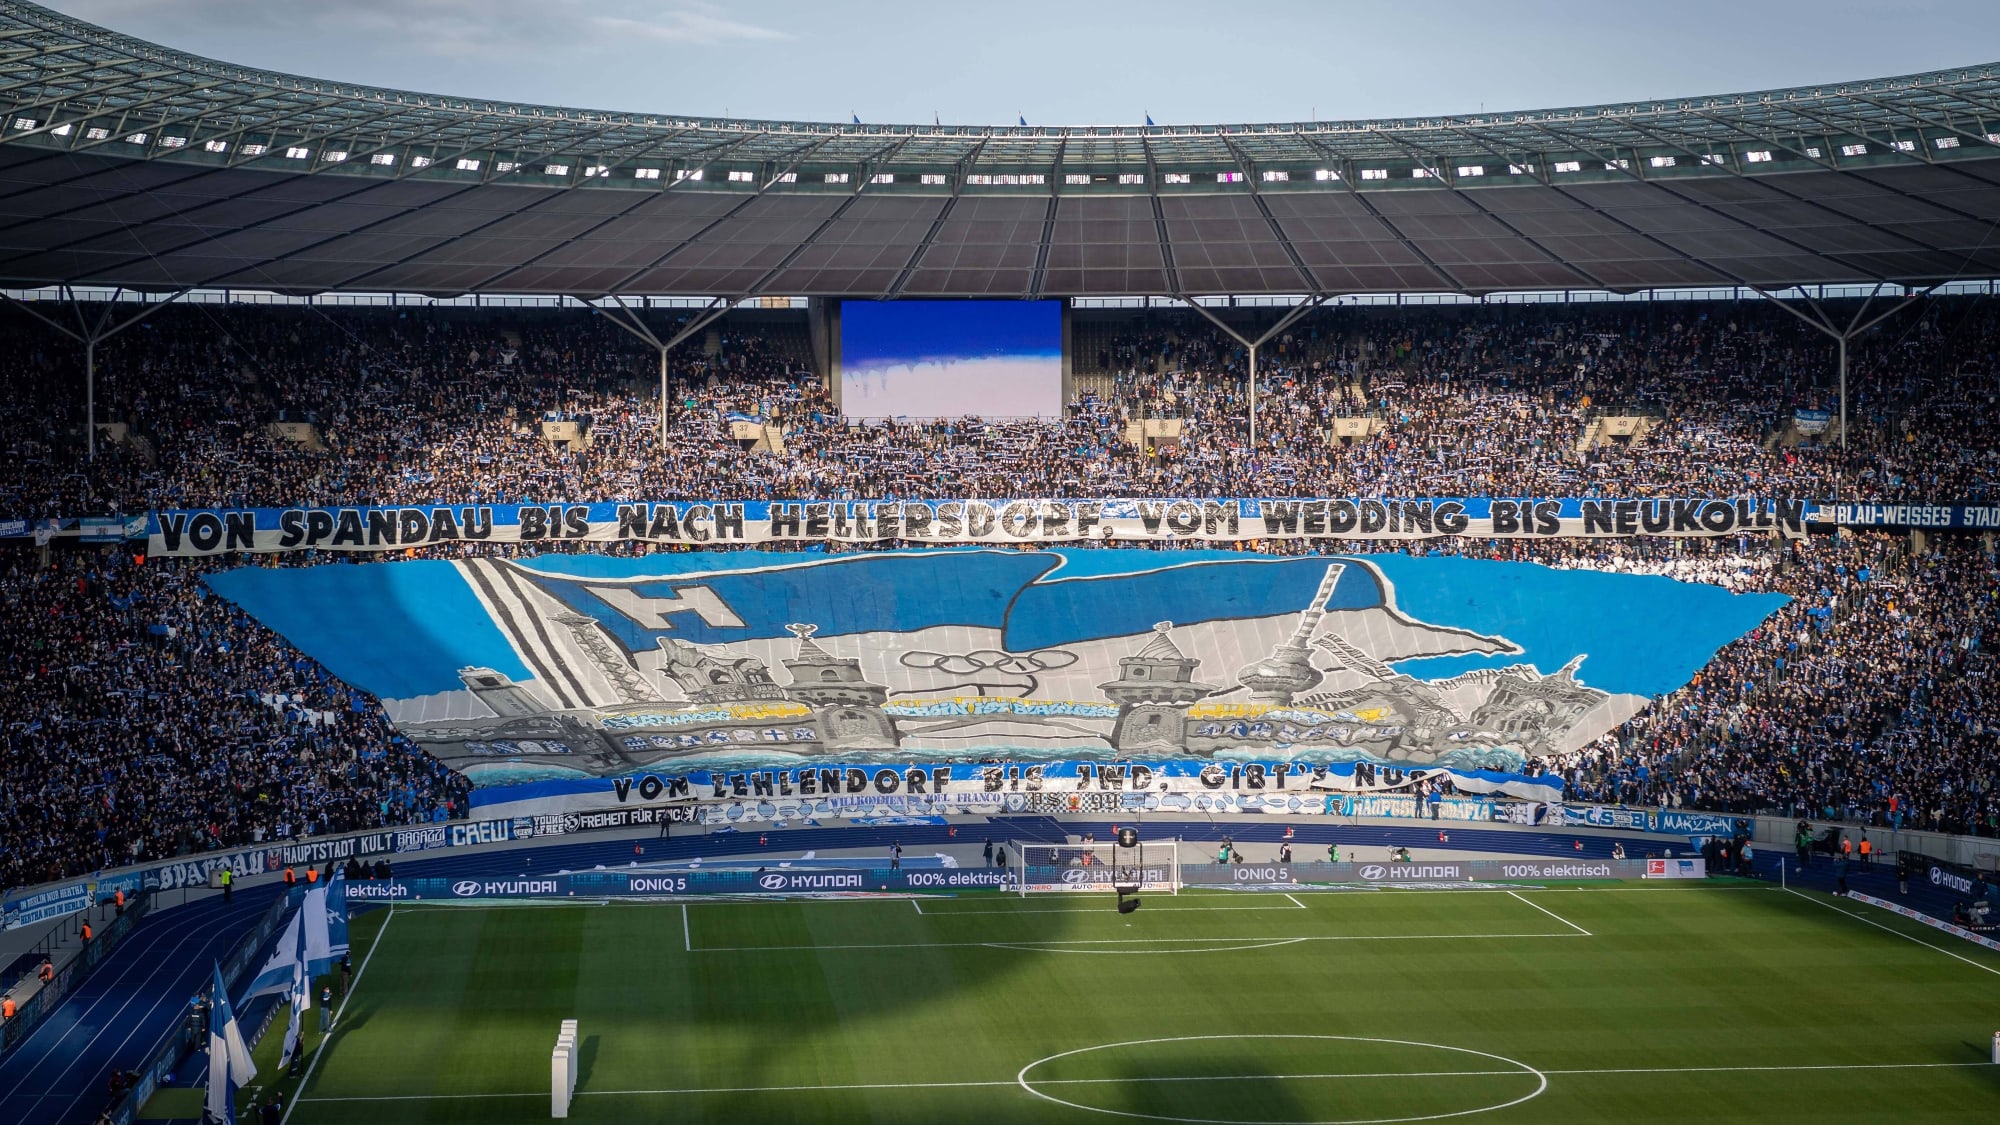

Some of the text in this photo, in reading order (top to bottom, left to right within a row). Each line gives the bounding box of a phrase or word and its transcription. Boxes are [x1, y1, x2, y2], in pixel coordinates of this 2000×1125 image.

[1837, 505, 1951, 526] BLAU-WEISSES
[158, 511, 256, 551] VON
[279, 505, 493, 548] SPANDAU
[518, 505, 590, 540] BIS
[617, 503, 745, 541] NACH
[1136, 499, 1239, 536] VOM
[1259, 499, 1470, 535] WEDDING
[1490, 499, 1562, 536] BIS
[711, 767, 951, 798] ZEHLENDORF
[983, 766, 1044, 792] BIS
[1076, 764, 1168, 792] JWD,
[830, 795, 905, 808] WILLKOMMEN
[957, 793, 1000, 804] FRANCO
[534, 815, 564, 825] YOUNG
[581, 810, 628, 828] FREIHEIT
[630, 808, 652, 823] FÜR
[452, 819, 508, 846] CREW
[284, 838, 356, 863] HAUPTSTADT
[361, 833, 392, 853] KULT
[1234, 867, 1288, 882] IONIQ 5
[1390, 866, 1460, 879] HYUNDAI
[1503, 863, 1611, 878] 100% elektrisch
[630, 878, 686, 892] IONIQ 5
[791, 875, 862, 888] HYUNDAI
[906, 871, 1018, 886] 100% elektrisch
[1942, 871, 1972, 893] HYUNDA
[59, 884, 84, 900] HERTHA
[345, 883, 407, 897] lektrisch
[484, 881, 557, 894] HYUNDAI
